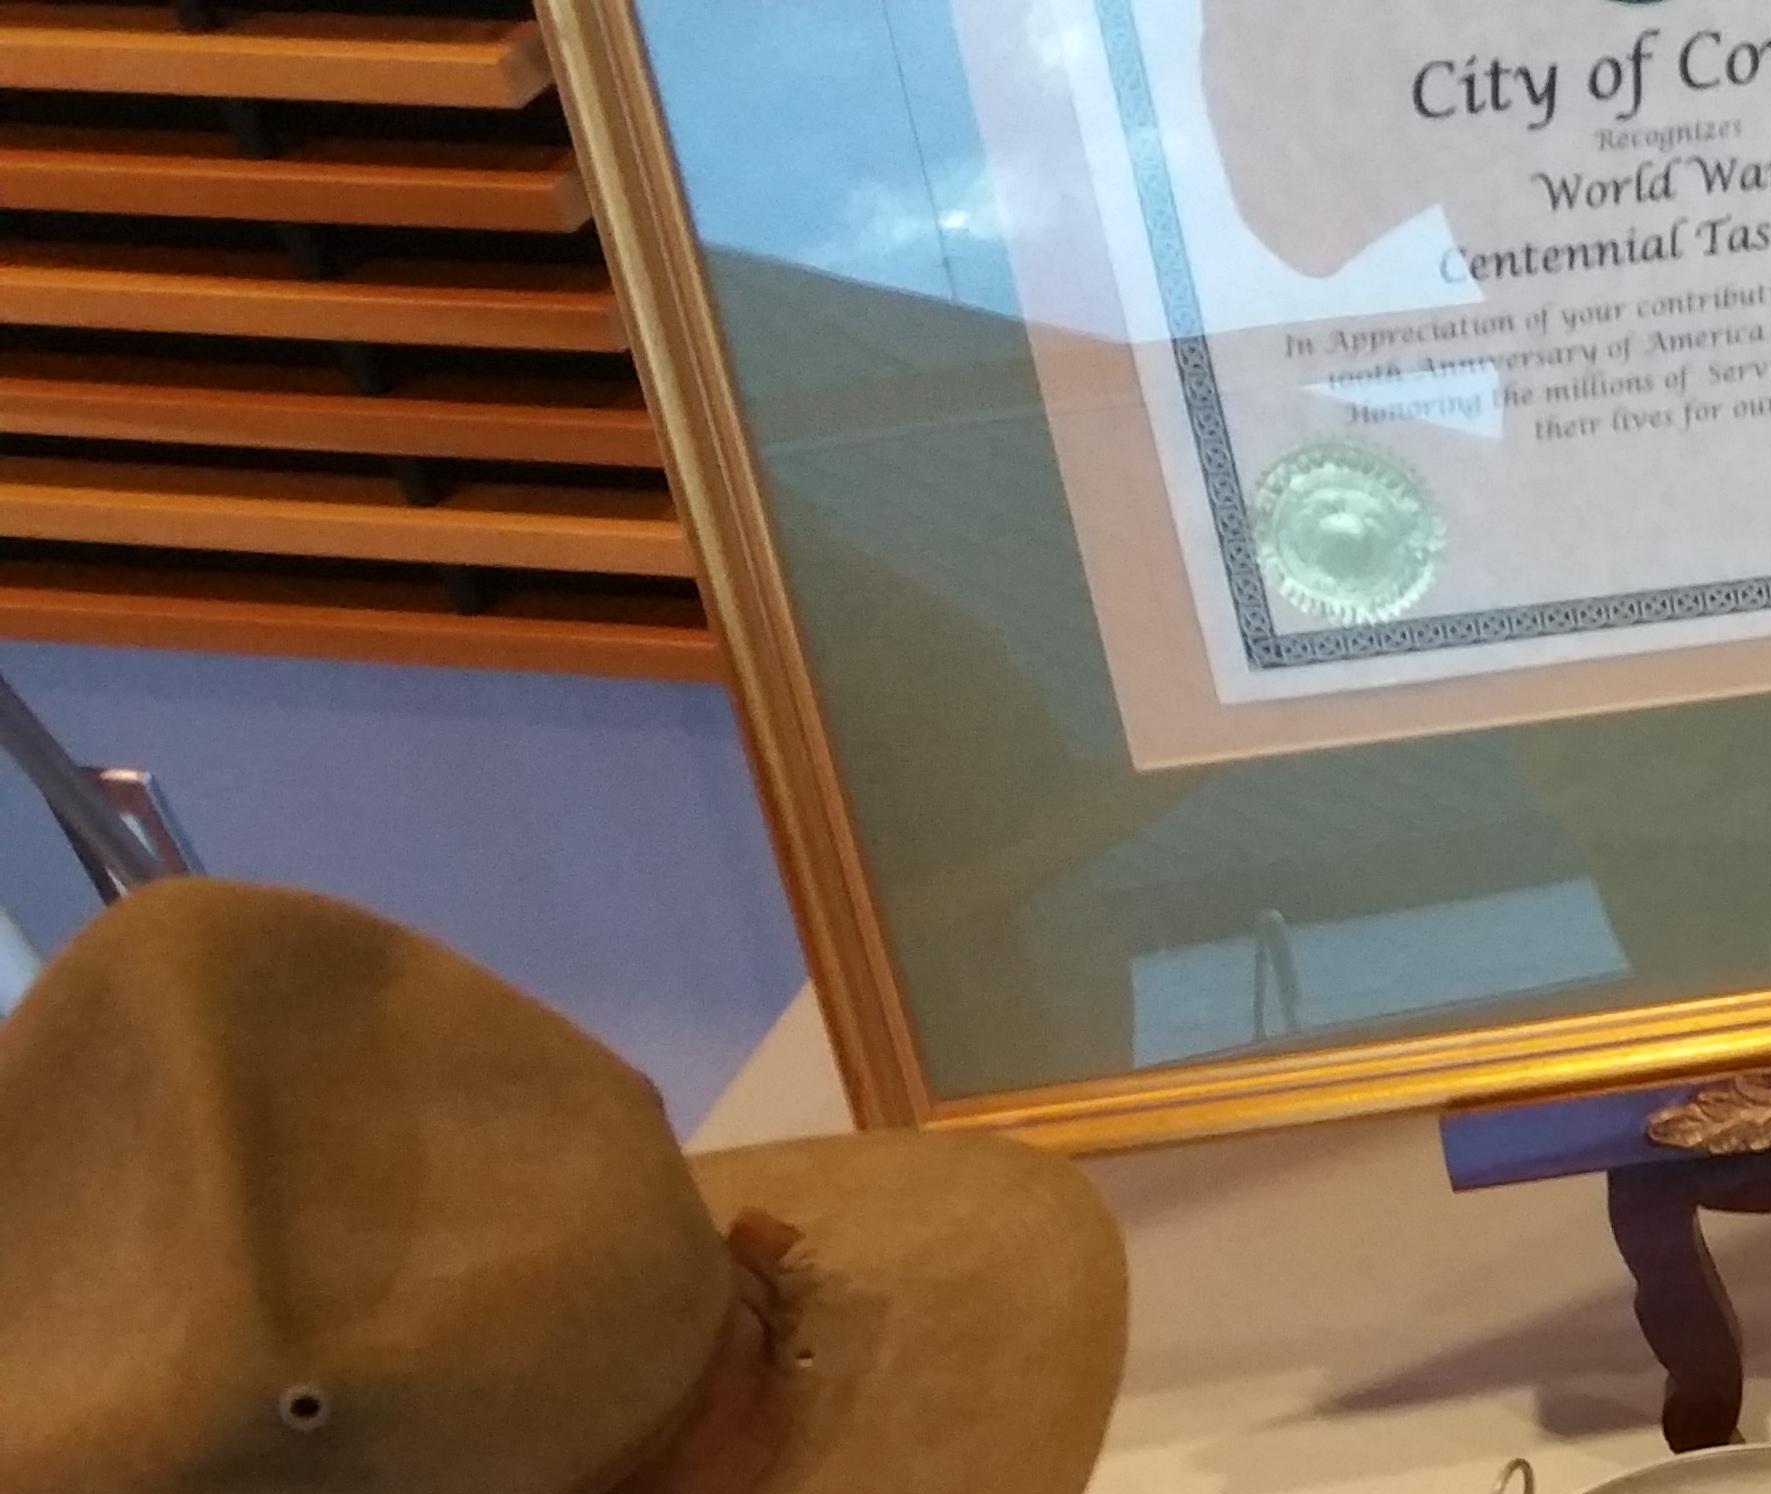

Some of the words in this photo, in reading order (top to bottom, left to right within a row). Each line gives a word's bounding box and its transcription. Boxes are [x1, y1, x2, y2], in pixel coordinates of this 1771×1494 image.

[1412, 55, 1559, 131] City
[1588, 28, 1660, 121] of
[1598, 118, 1743, 152] Recognizes
[1532, 160, 1674, 212] World
[1440, 217, 1683, 285] Centennial
[1285, 334, 1314, 358] In
[1325, 313, 1515, 356] Appreciation
[1524, 308, 1550, 336] of
[1562, 302, 1625, 328] your
[1421, 341, 1597, 378] Anniversary
[1607, 335, 1632, 362] of
[1642, 325, 1764, 354] America
[1491, 383, 1534, 411] the
[1544, 372, 1654, 404] millions
[1664, 365, 1689, 393] of
[1535, 411, 1601, 441] their
[1612, 404, 1673, 433] lives
[1682, 399, 1721, 429] for
